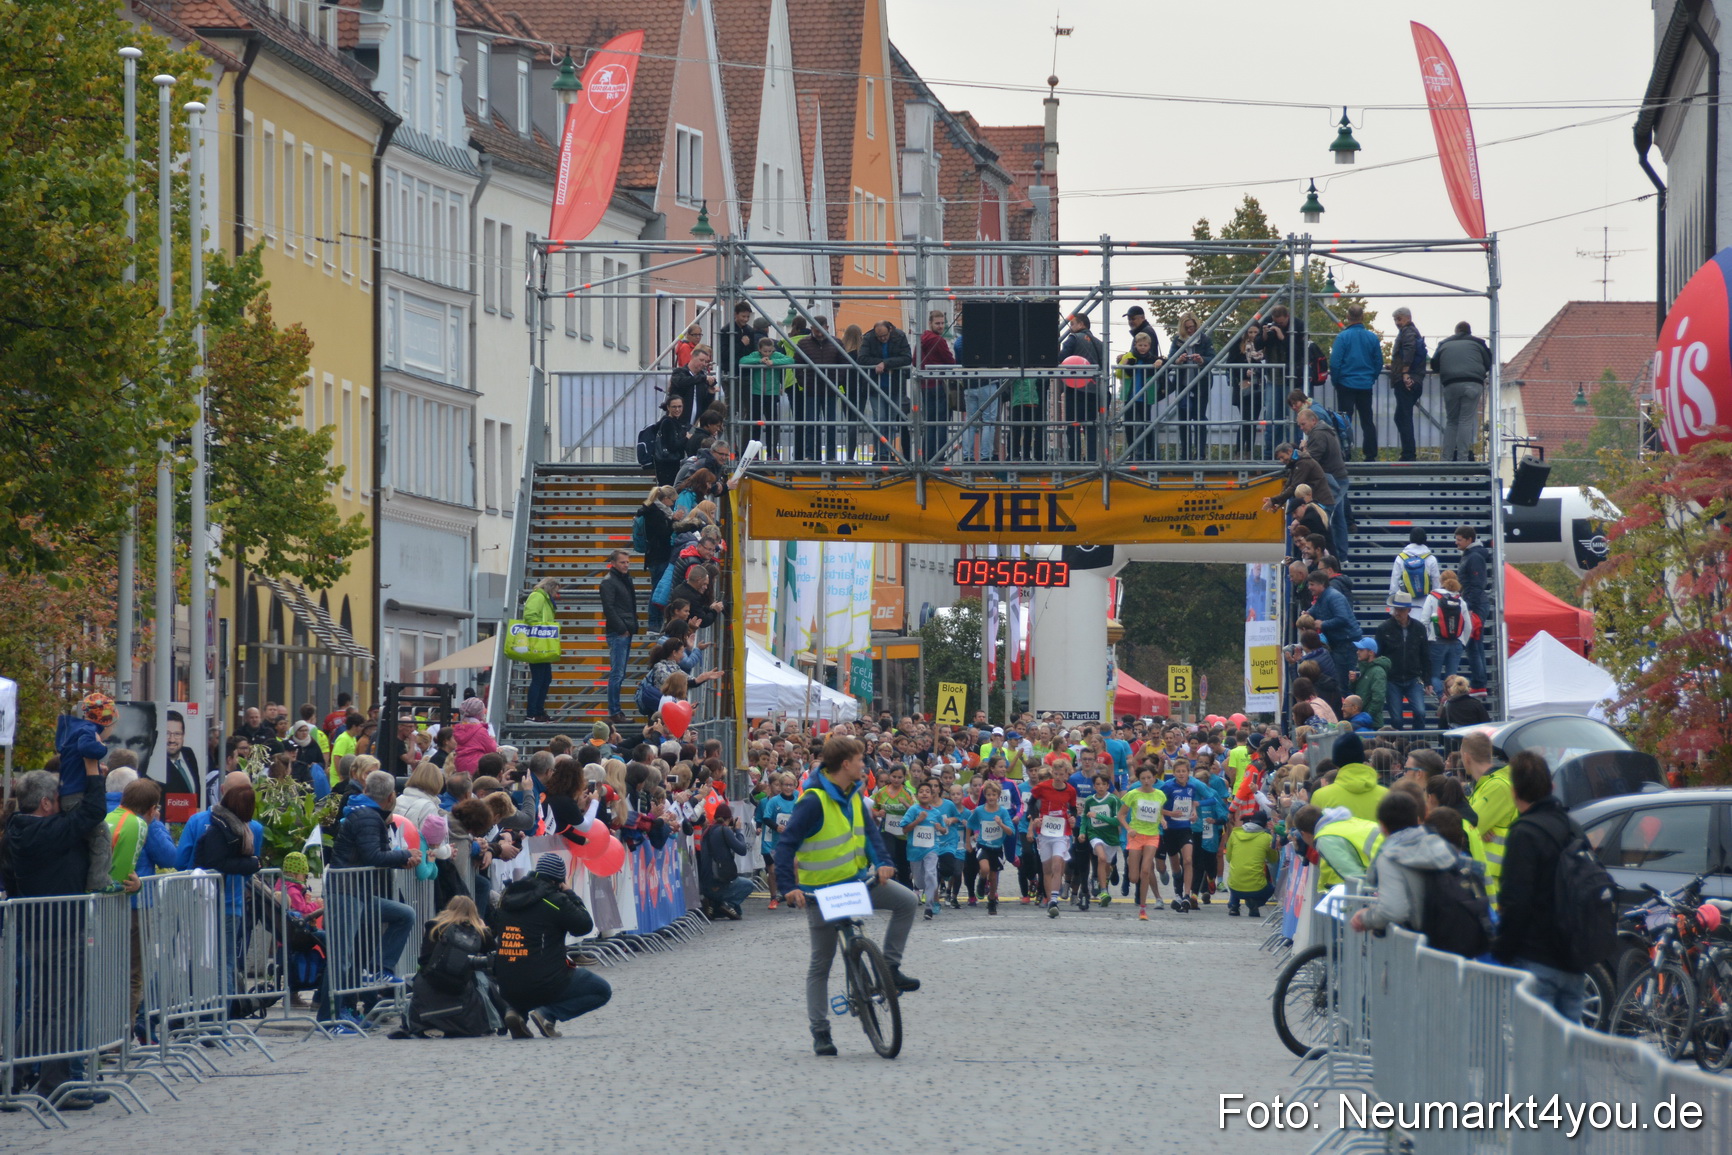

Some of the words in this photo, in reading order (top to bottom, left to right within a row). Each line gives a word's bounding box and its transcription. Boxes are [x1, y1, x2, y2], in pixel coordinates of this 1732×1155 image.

[775, 508, 838, 519] Neumarkter
[840, 511, 890, 522] Stadtlauf
[957, 493, 1077, 532] ZIEL
[1143, 513, 1205, 524] Neumarkter
[1208, 511, 1257, 521] Stadtlauf
[530, 626, 538, 636] it
[538, 628, 557, 638] easy
[1170, 666, 1190, 674] Block
[1260, 667, 1274, 676] lauf
[942, 683, 964, 694] Block
[1174, 676, 1186, 693] B
[942, 695, 959, 717] A
[167, 798, 190, 807] Foitzik
[1140, 805, 1157, 814] 4004
[888, 820, 900, 828] 403
[1044, 821, 1062, 831] 4000
[916, 831, 932, 840] 4033
[501, 931, 525, 940] FOTO-
[501, 940, 525, 948] TEAM-
[498, 948, 529, 957] MUELLER
